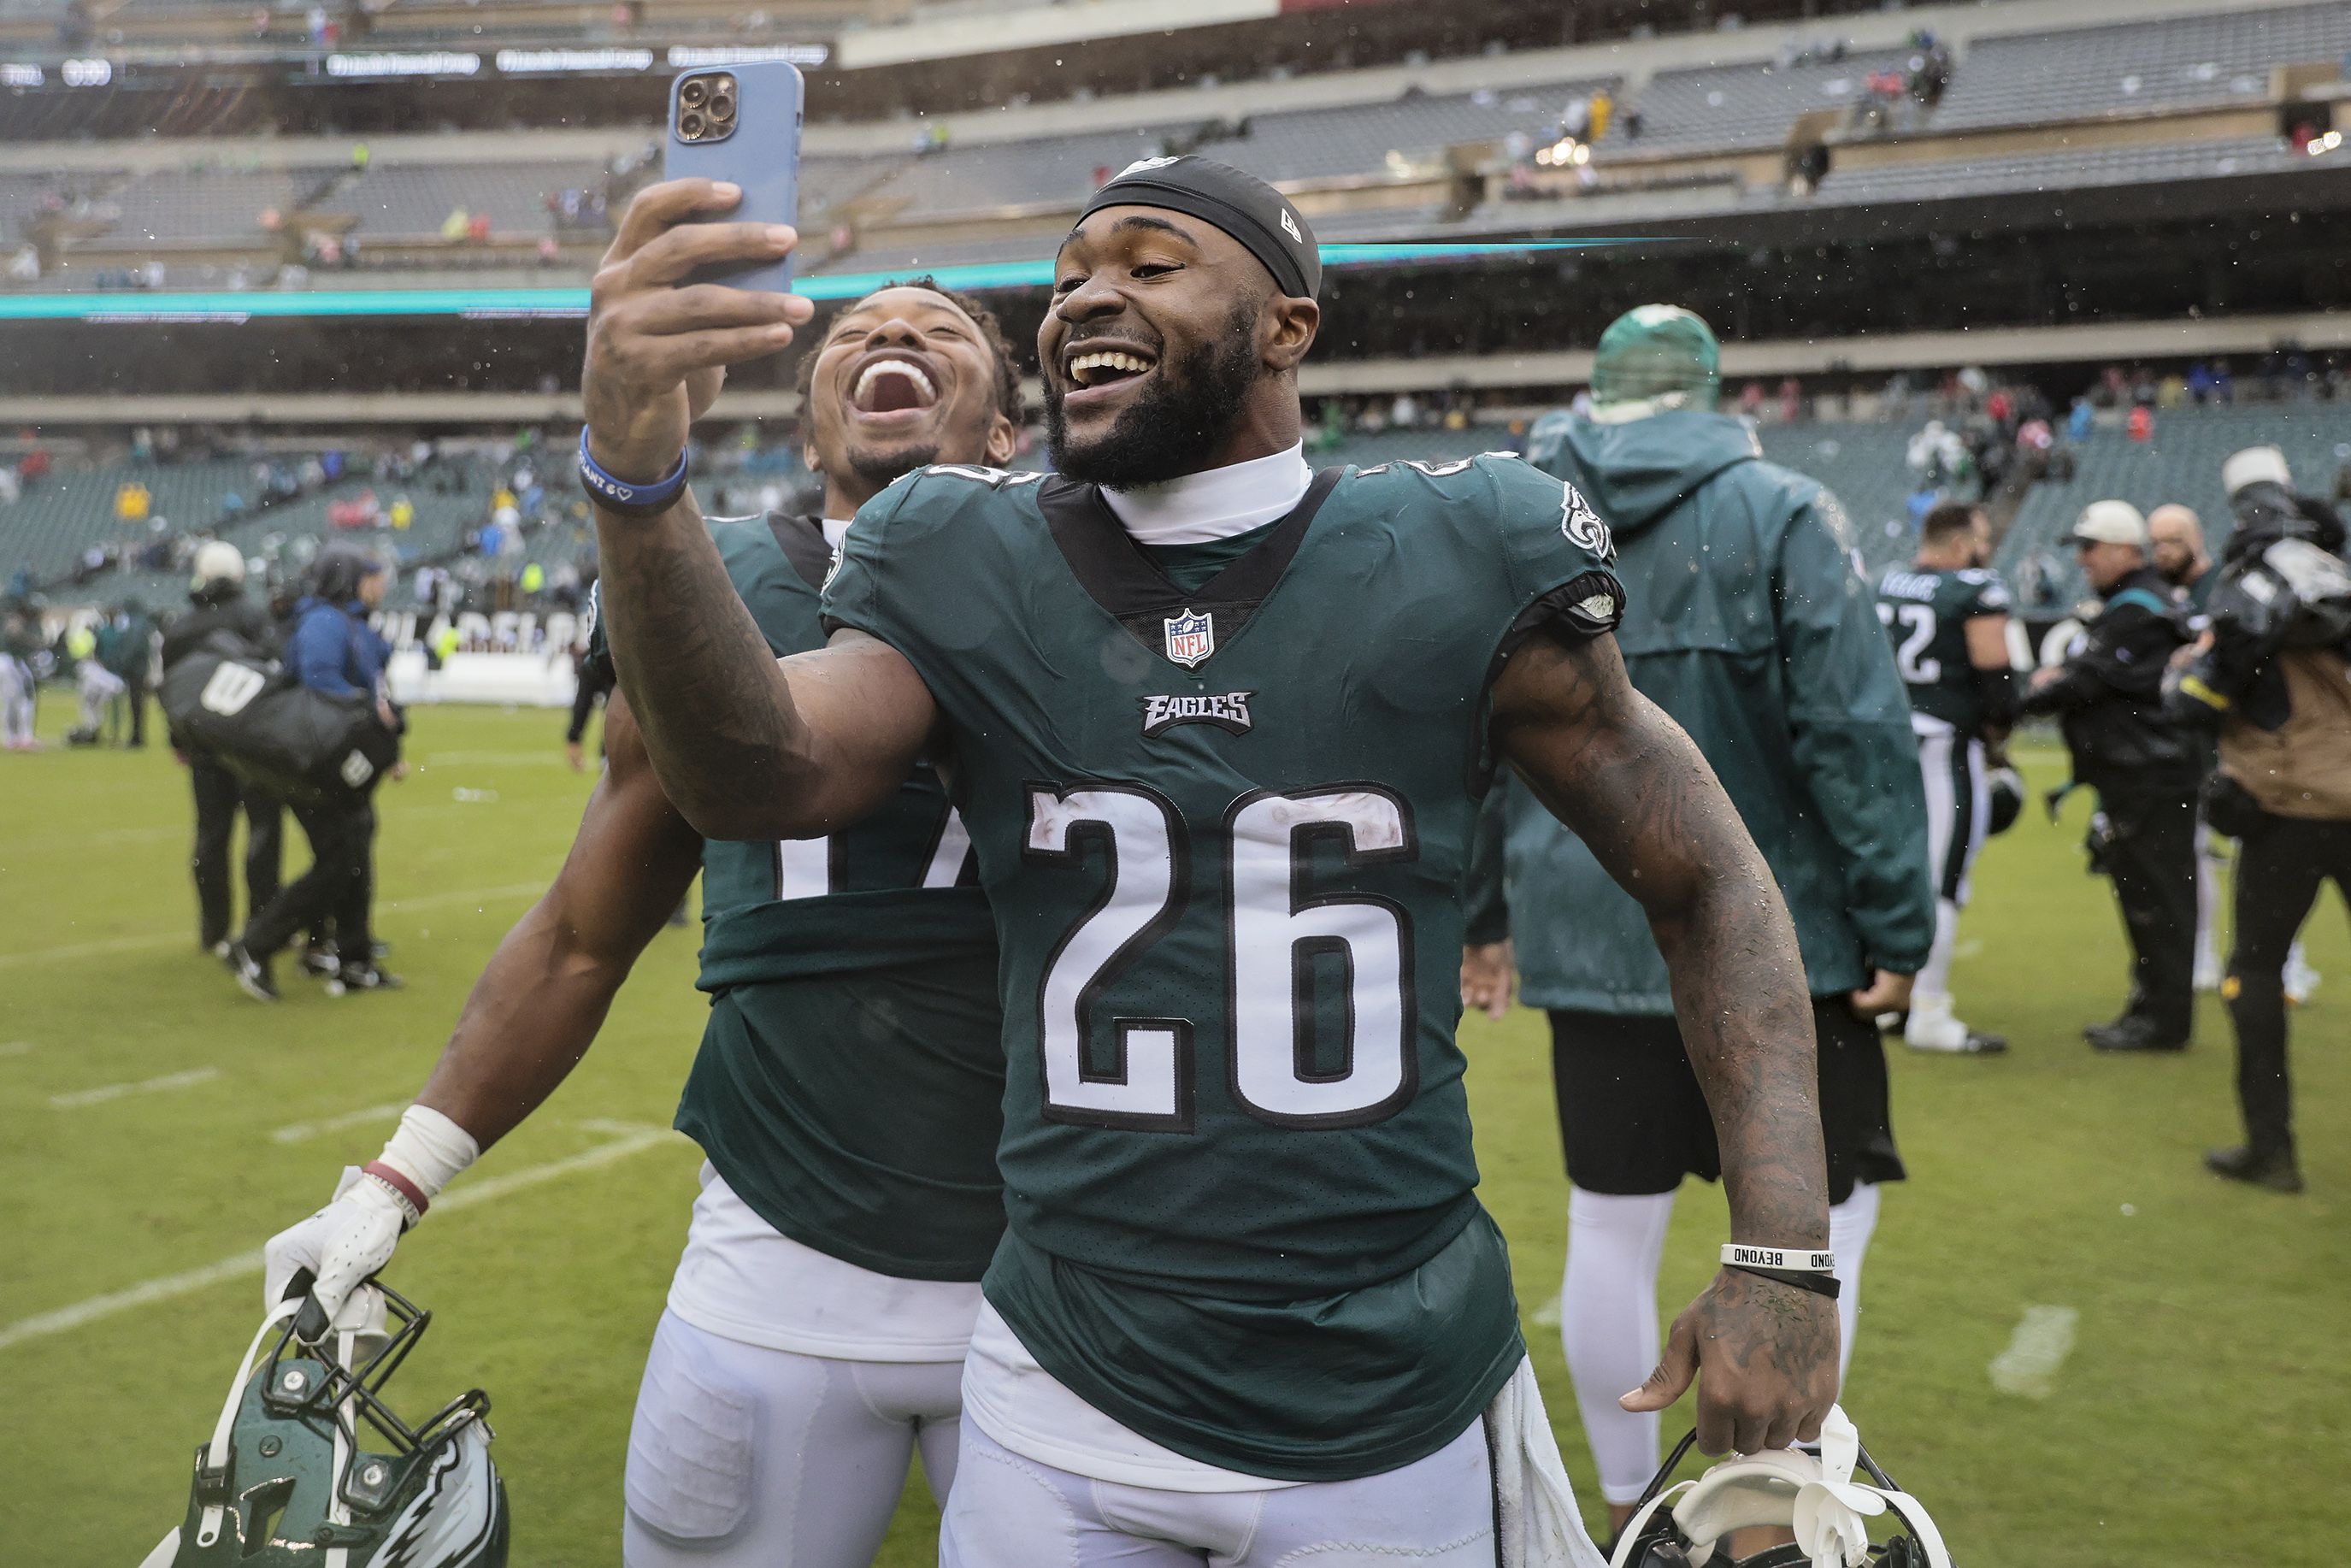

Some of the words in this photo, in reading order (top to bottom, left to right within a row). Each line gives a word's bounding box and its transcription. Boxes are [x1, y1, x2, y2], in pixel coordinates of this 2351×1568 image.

[1173, 634, 1206, 657] NFL
[1875, 601, 1941, 684] 2
[1143, 692, 1252, 731] EAGLES
[1025, 783, 1415, 1125] 26
[1735, 1248, 1783, 1266] BEYOND
